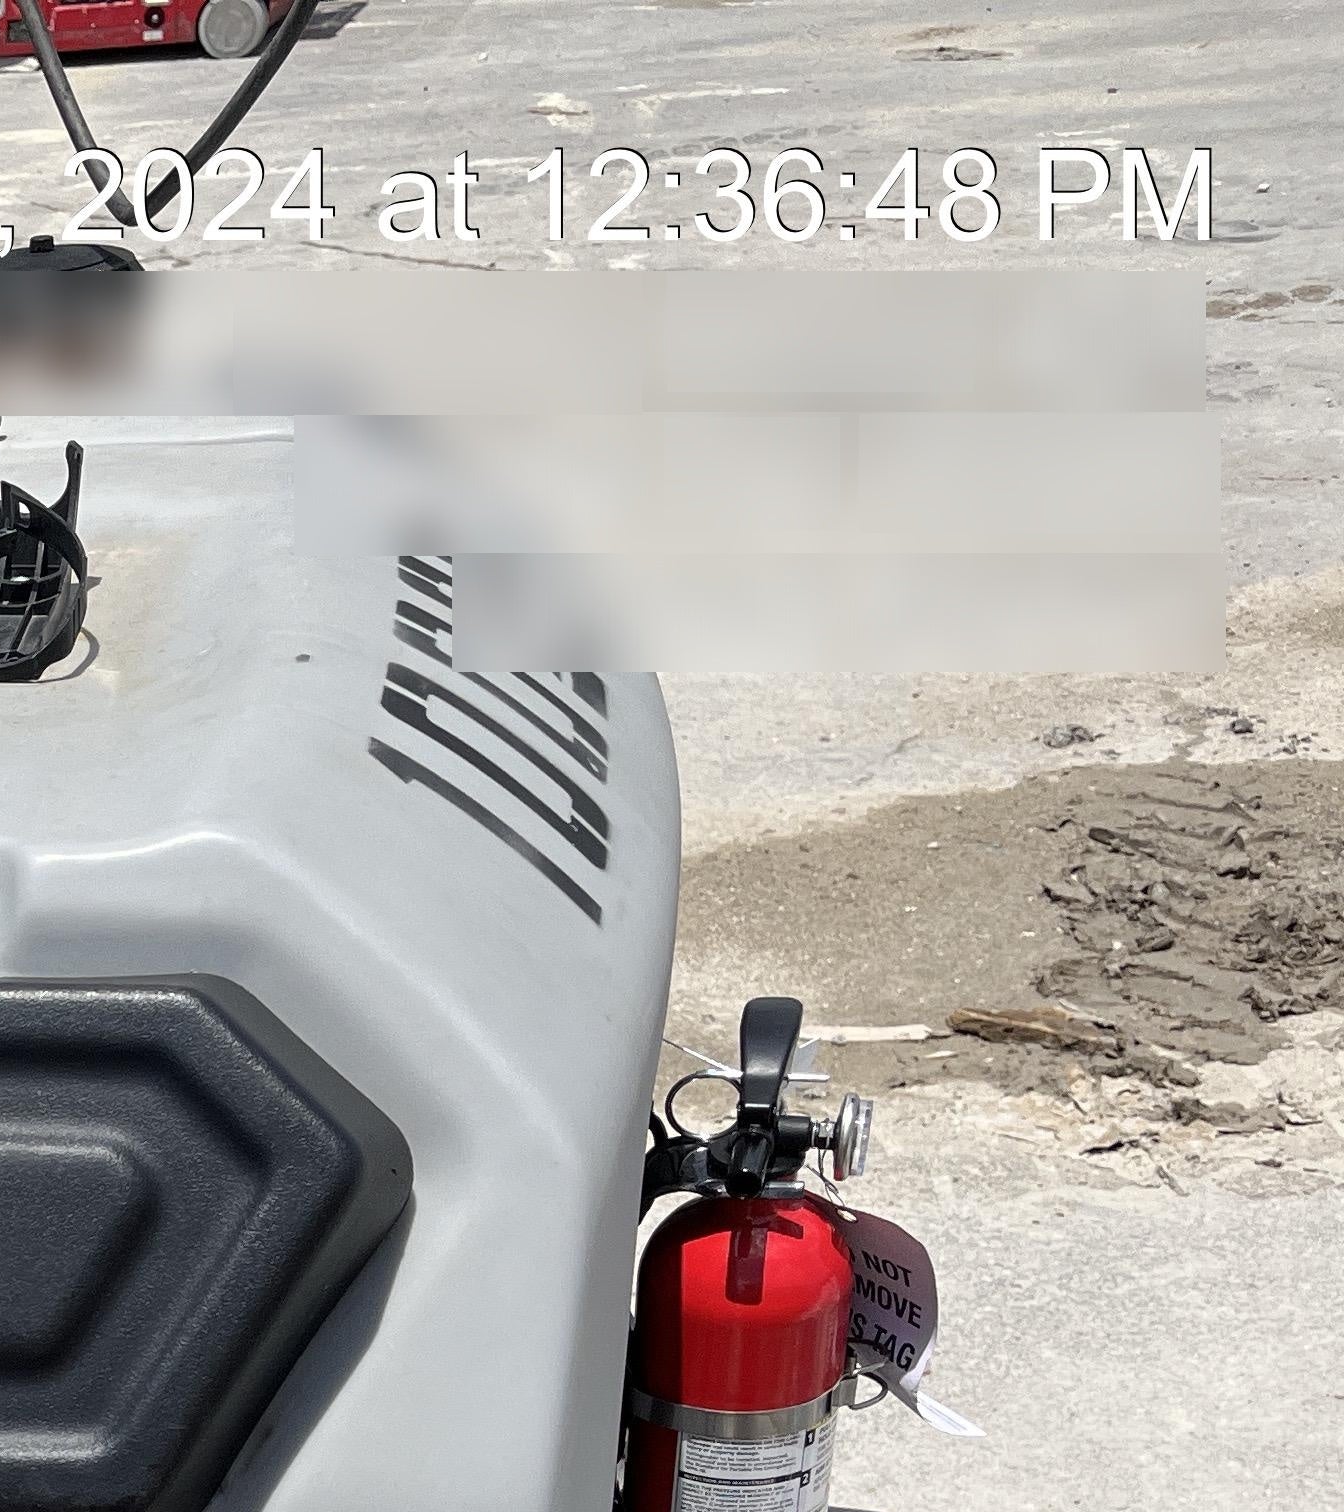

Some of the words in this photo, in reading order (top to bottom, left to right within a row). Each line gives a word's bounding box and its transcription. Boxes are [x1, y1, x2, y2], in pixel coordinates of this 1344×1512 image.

[861, 1249, 912, 1288] NOT
[851, 1273, 922, 1329] MOVE
[873, 1322, 916, 1373] TAG
